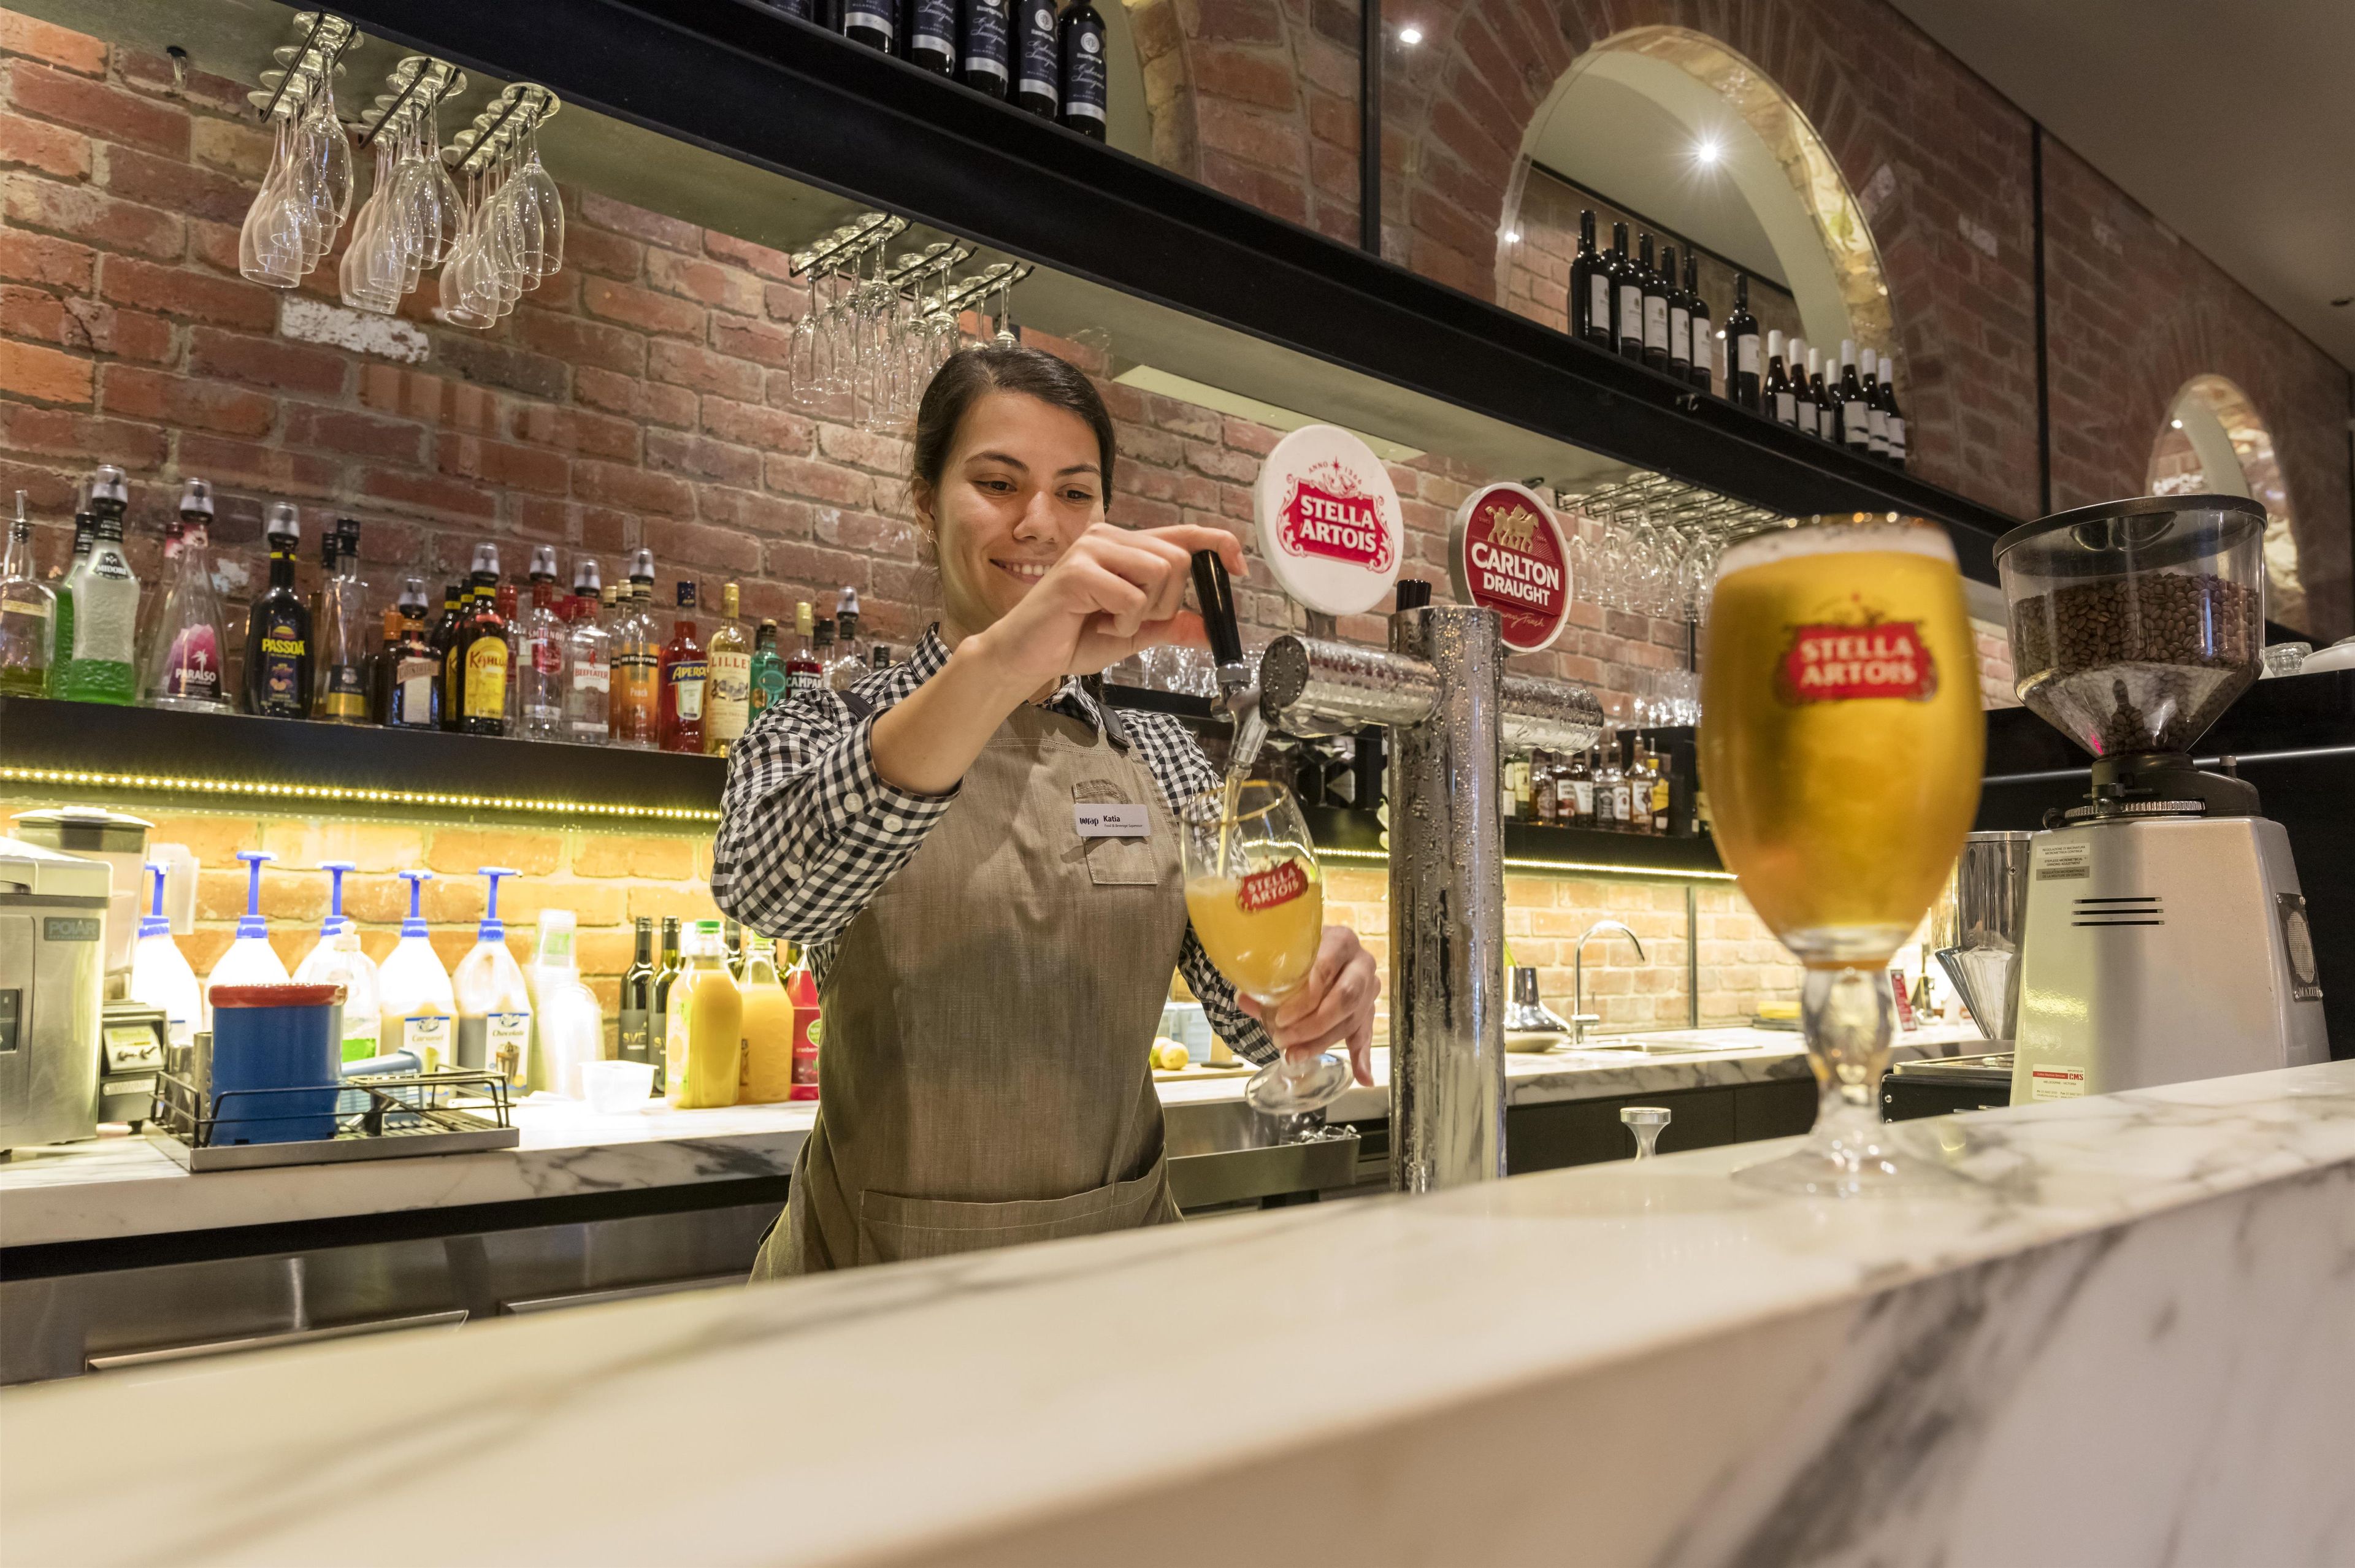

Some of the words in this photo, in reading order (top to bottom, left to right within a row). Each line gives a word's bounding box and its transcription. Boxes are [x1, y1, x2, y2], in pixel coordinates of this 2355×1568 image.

[1308, 461, 1328, 474] ANNO
[1300, 494, 1376, 530] STELLA
[1300, 518, 1377, 552] ARTOIS
[96, 564, 128, 575] MIDORI
[1471, 541, 1560, 591] CARLTON
[1483, 572, 1551, 606] DRAUGHT
[1798, 635, 1915, 664] STELLA
[175, 668, 217, 683] PARAISO
[575, 668, 609, 680] BEEFEATER
[1801, 660, 1918, 688] ARTOIS
[1247, 867, 1296, 894] STELLA
[1251, 878, 1300, 906] ARTOIS
[48, 921, 97, 936] POLAR
[492, 1029, 524, 1038] Chocolate
